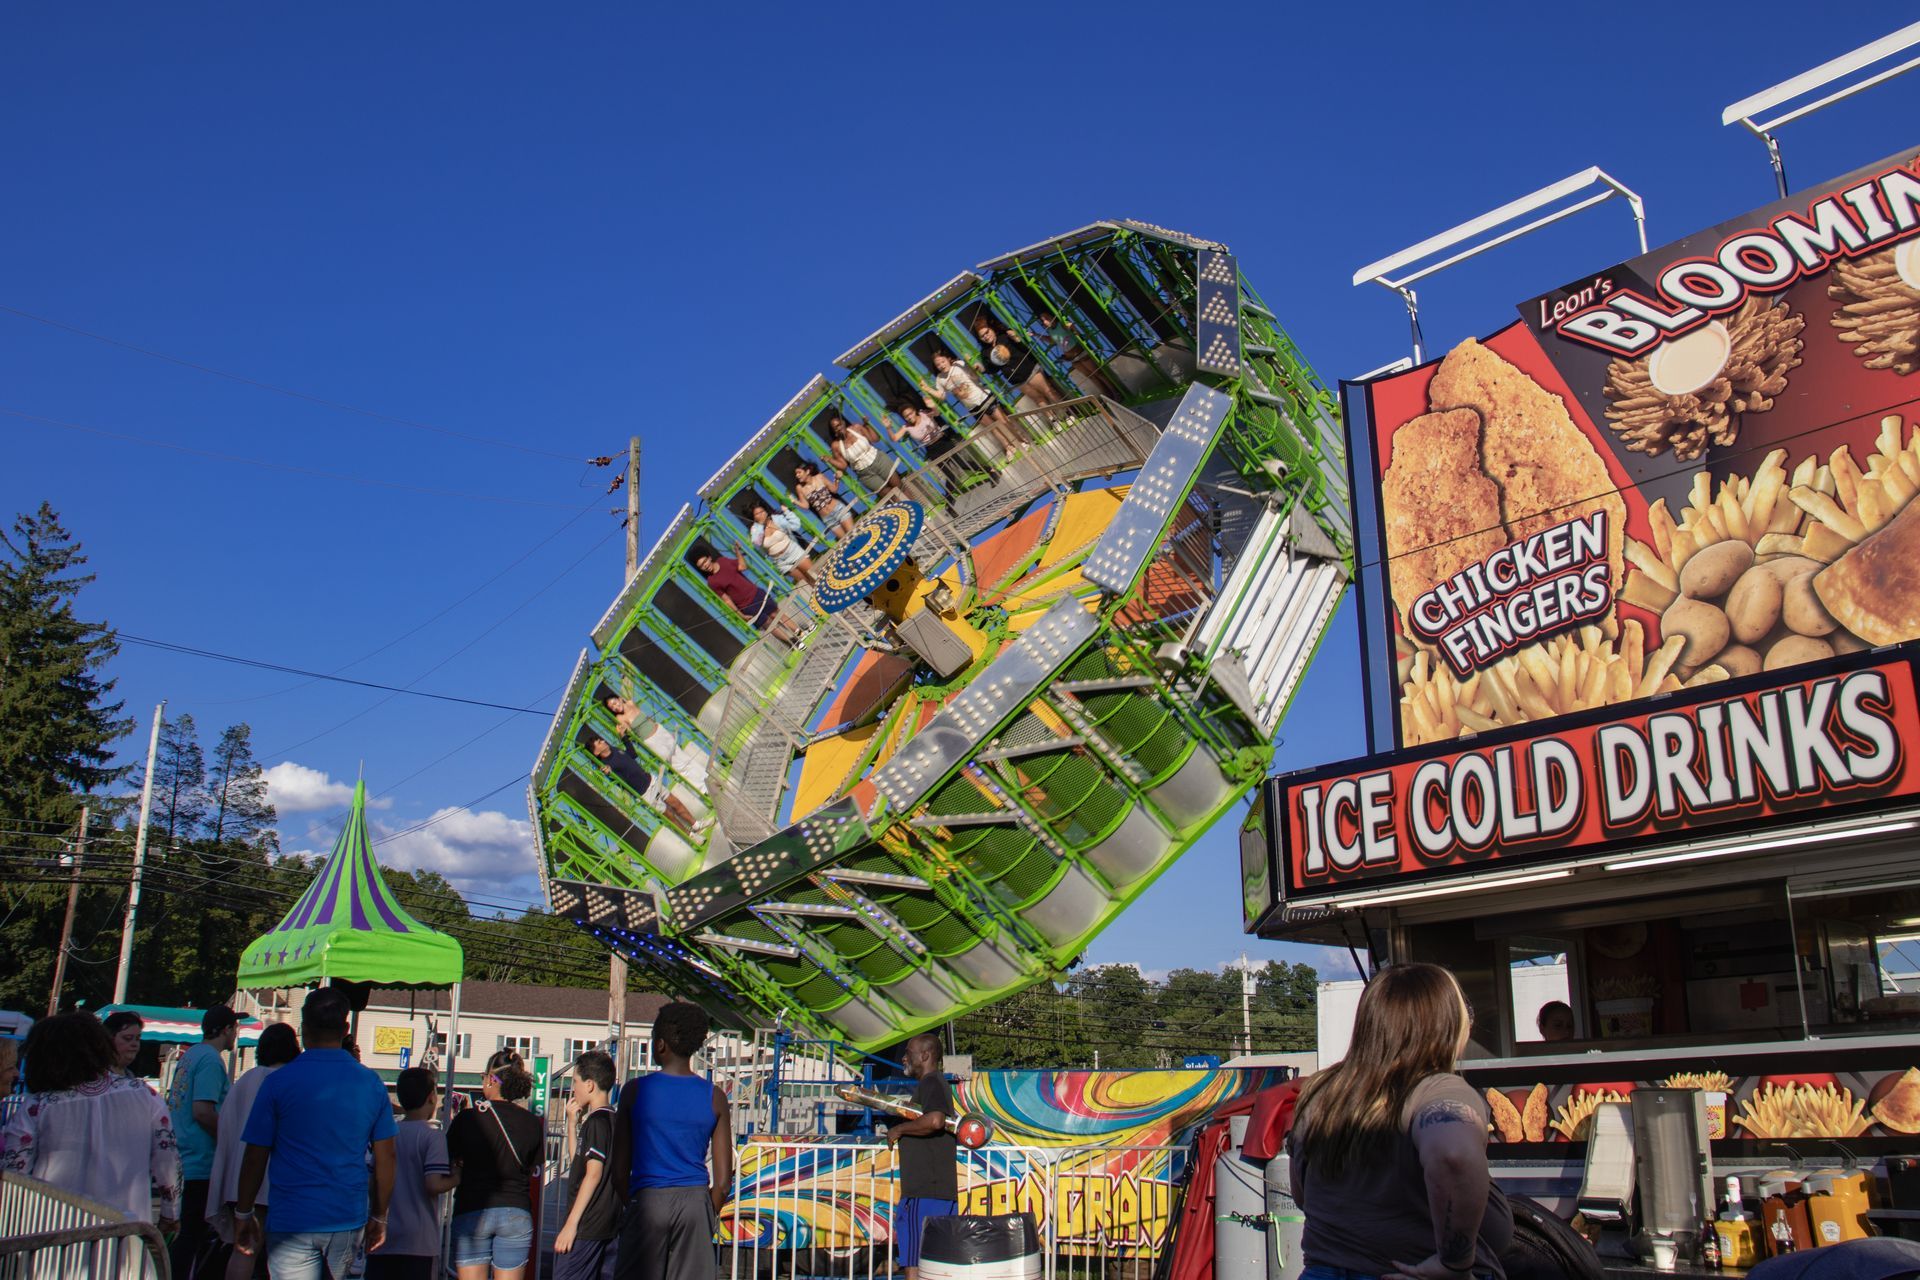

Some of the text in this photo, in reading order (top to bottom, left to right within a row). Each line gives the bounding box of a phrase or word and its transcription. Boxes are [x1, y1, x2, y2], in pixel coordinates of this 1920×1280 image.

[1539, 277, 1613, 330] Leon's
[1411, 512, 1607, 634] CHICKEN
[1441, 564, 1610, 670] FINGERS
[1300, 672, 1898, 872] ICE COLD DRINKS
[535, 1072, 547, 1117] YES
[957, 1171, 1175, 1248] ERO GRAV
